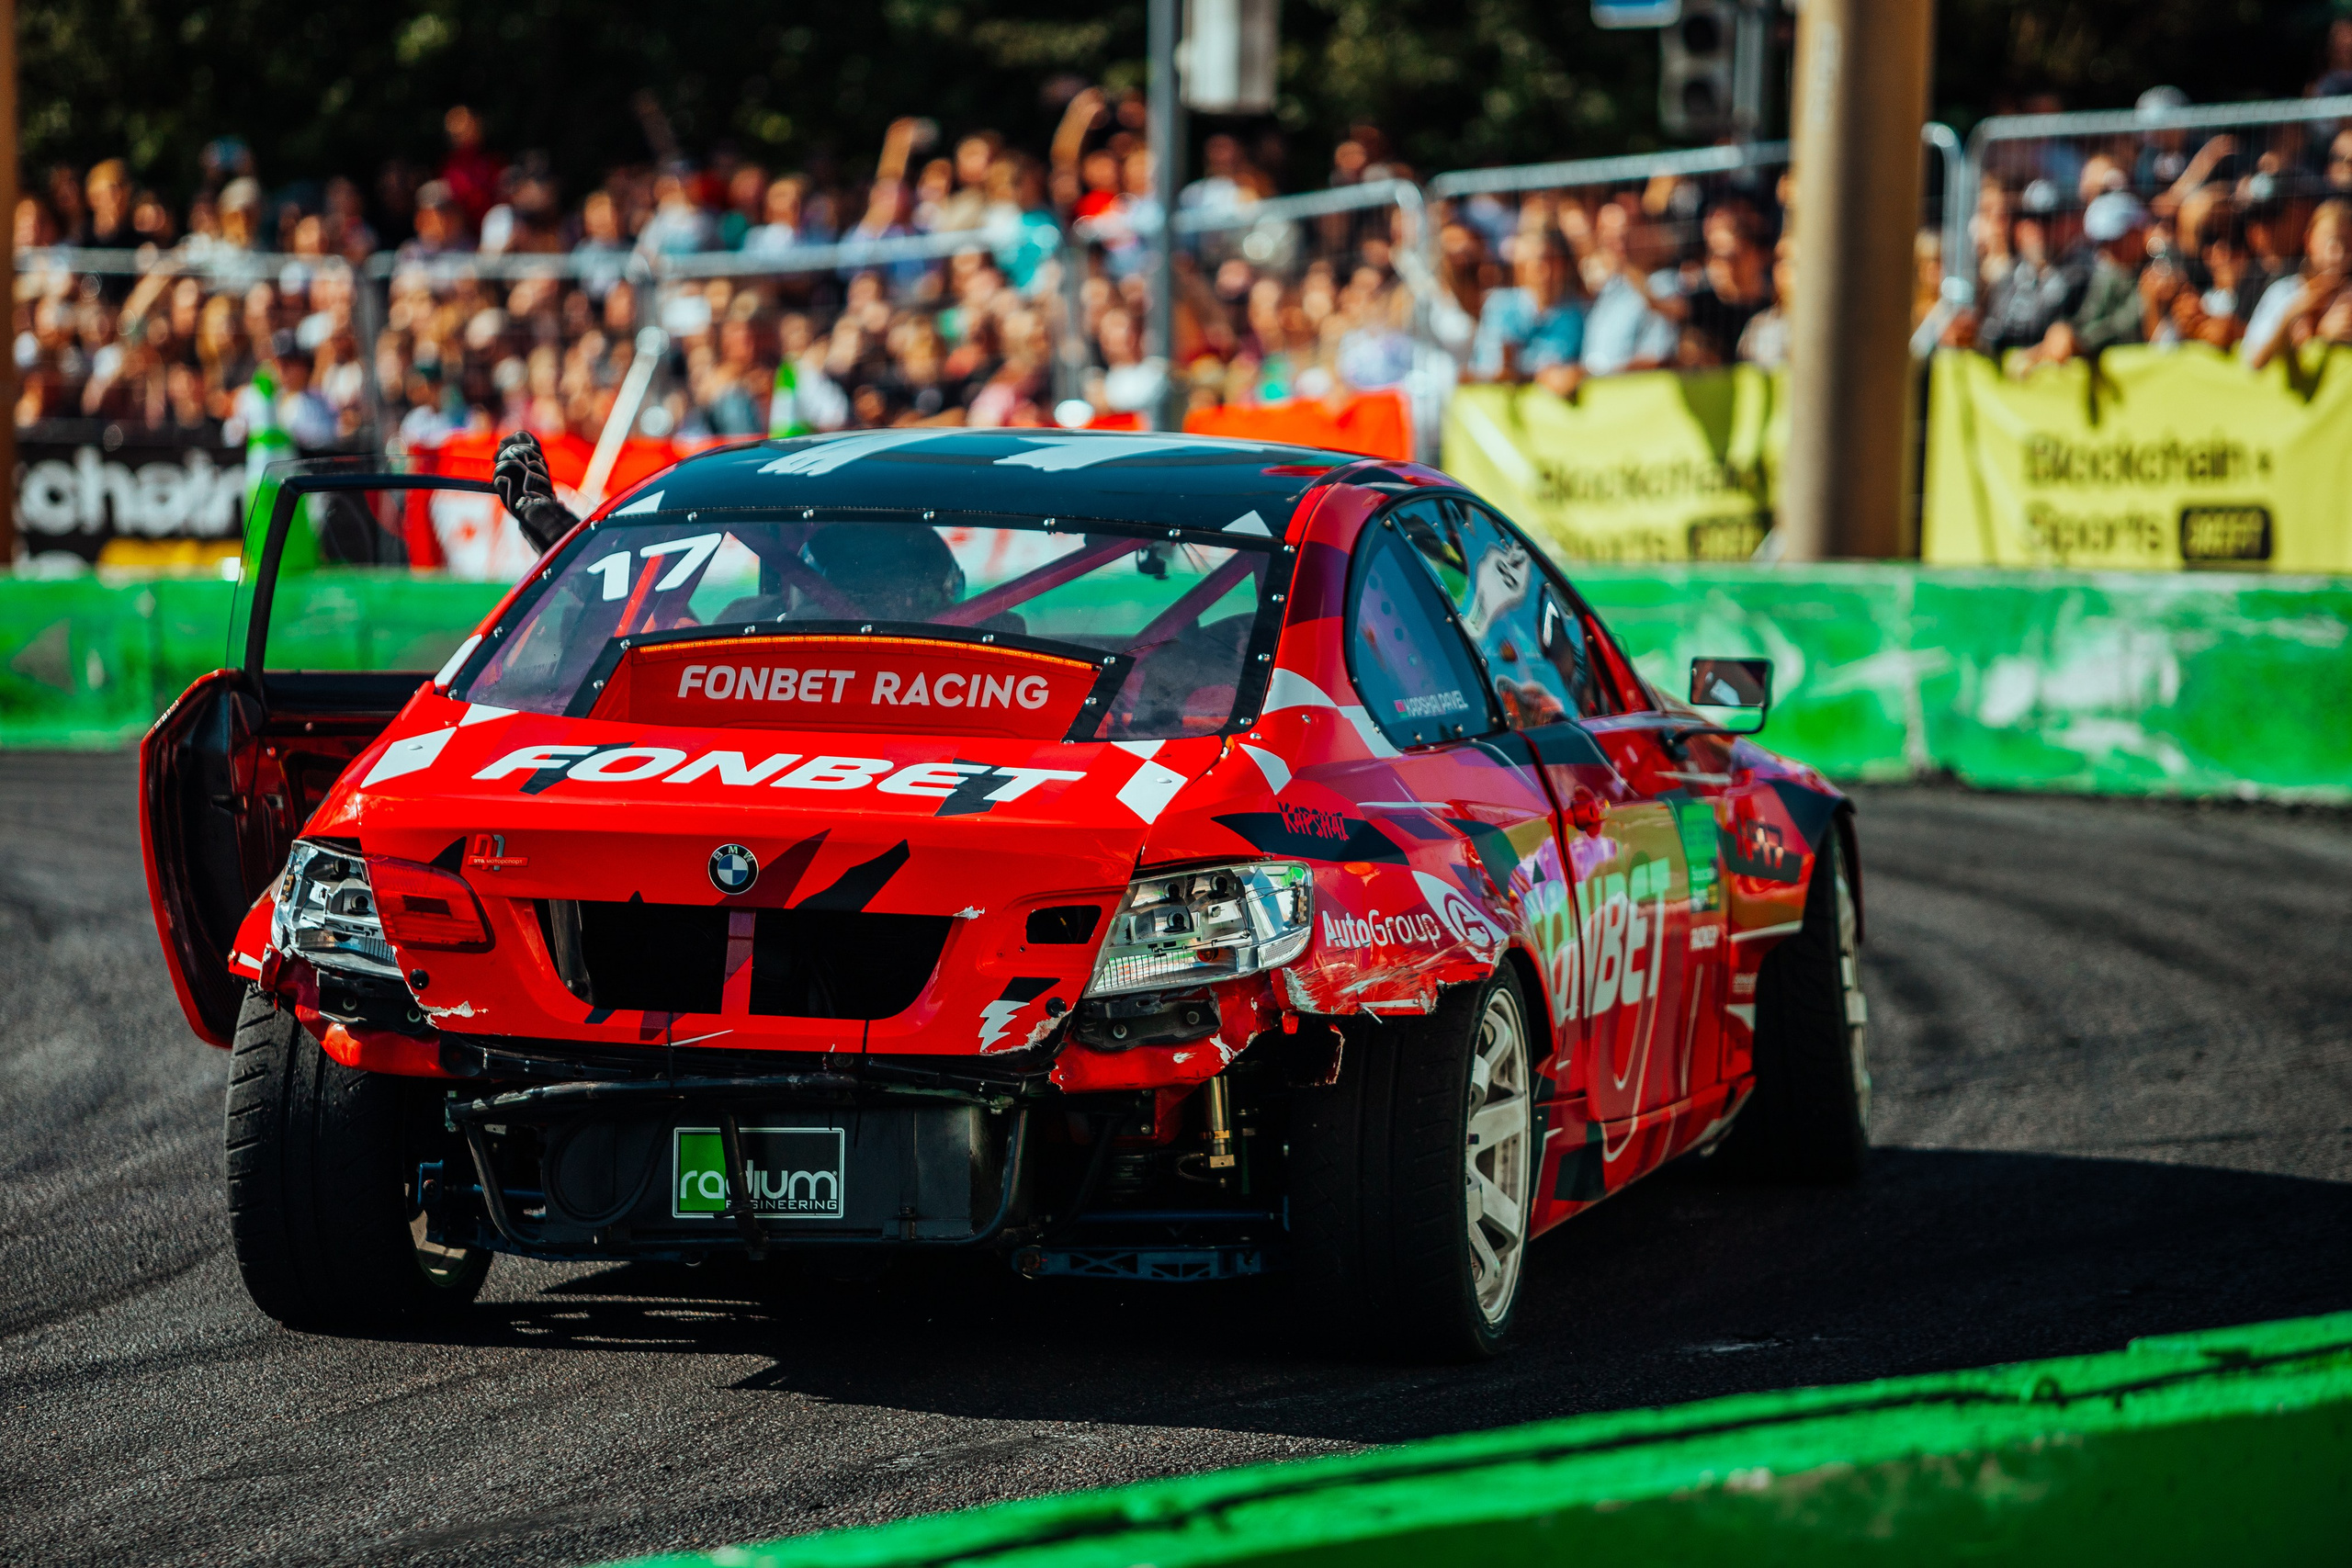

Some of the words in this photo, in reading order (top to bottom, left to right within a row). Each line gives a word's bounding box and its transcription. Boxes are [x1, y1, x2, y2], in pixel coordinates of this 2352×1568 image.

[587, 533, 722, 602] 17
[678, 665, 855, 703] FONBET
[871, 671, 1049, 710] RACING
[471, 745, 1087, 803] FONBET
[712, 845, 754, 863] BMW
[1322, 909, 1442, 950] AutoGroup
[726, 1200, 838, 1210] EGINEERING
